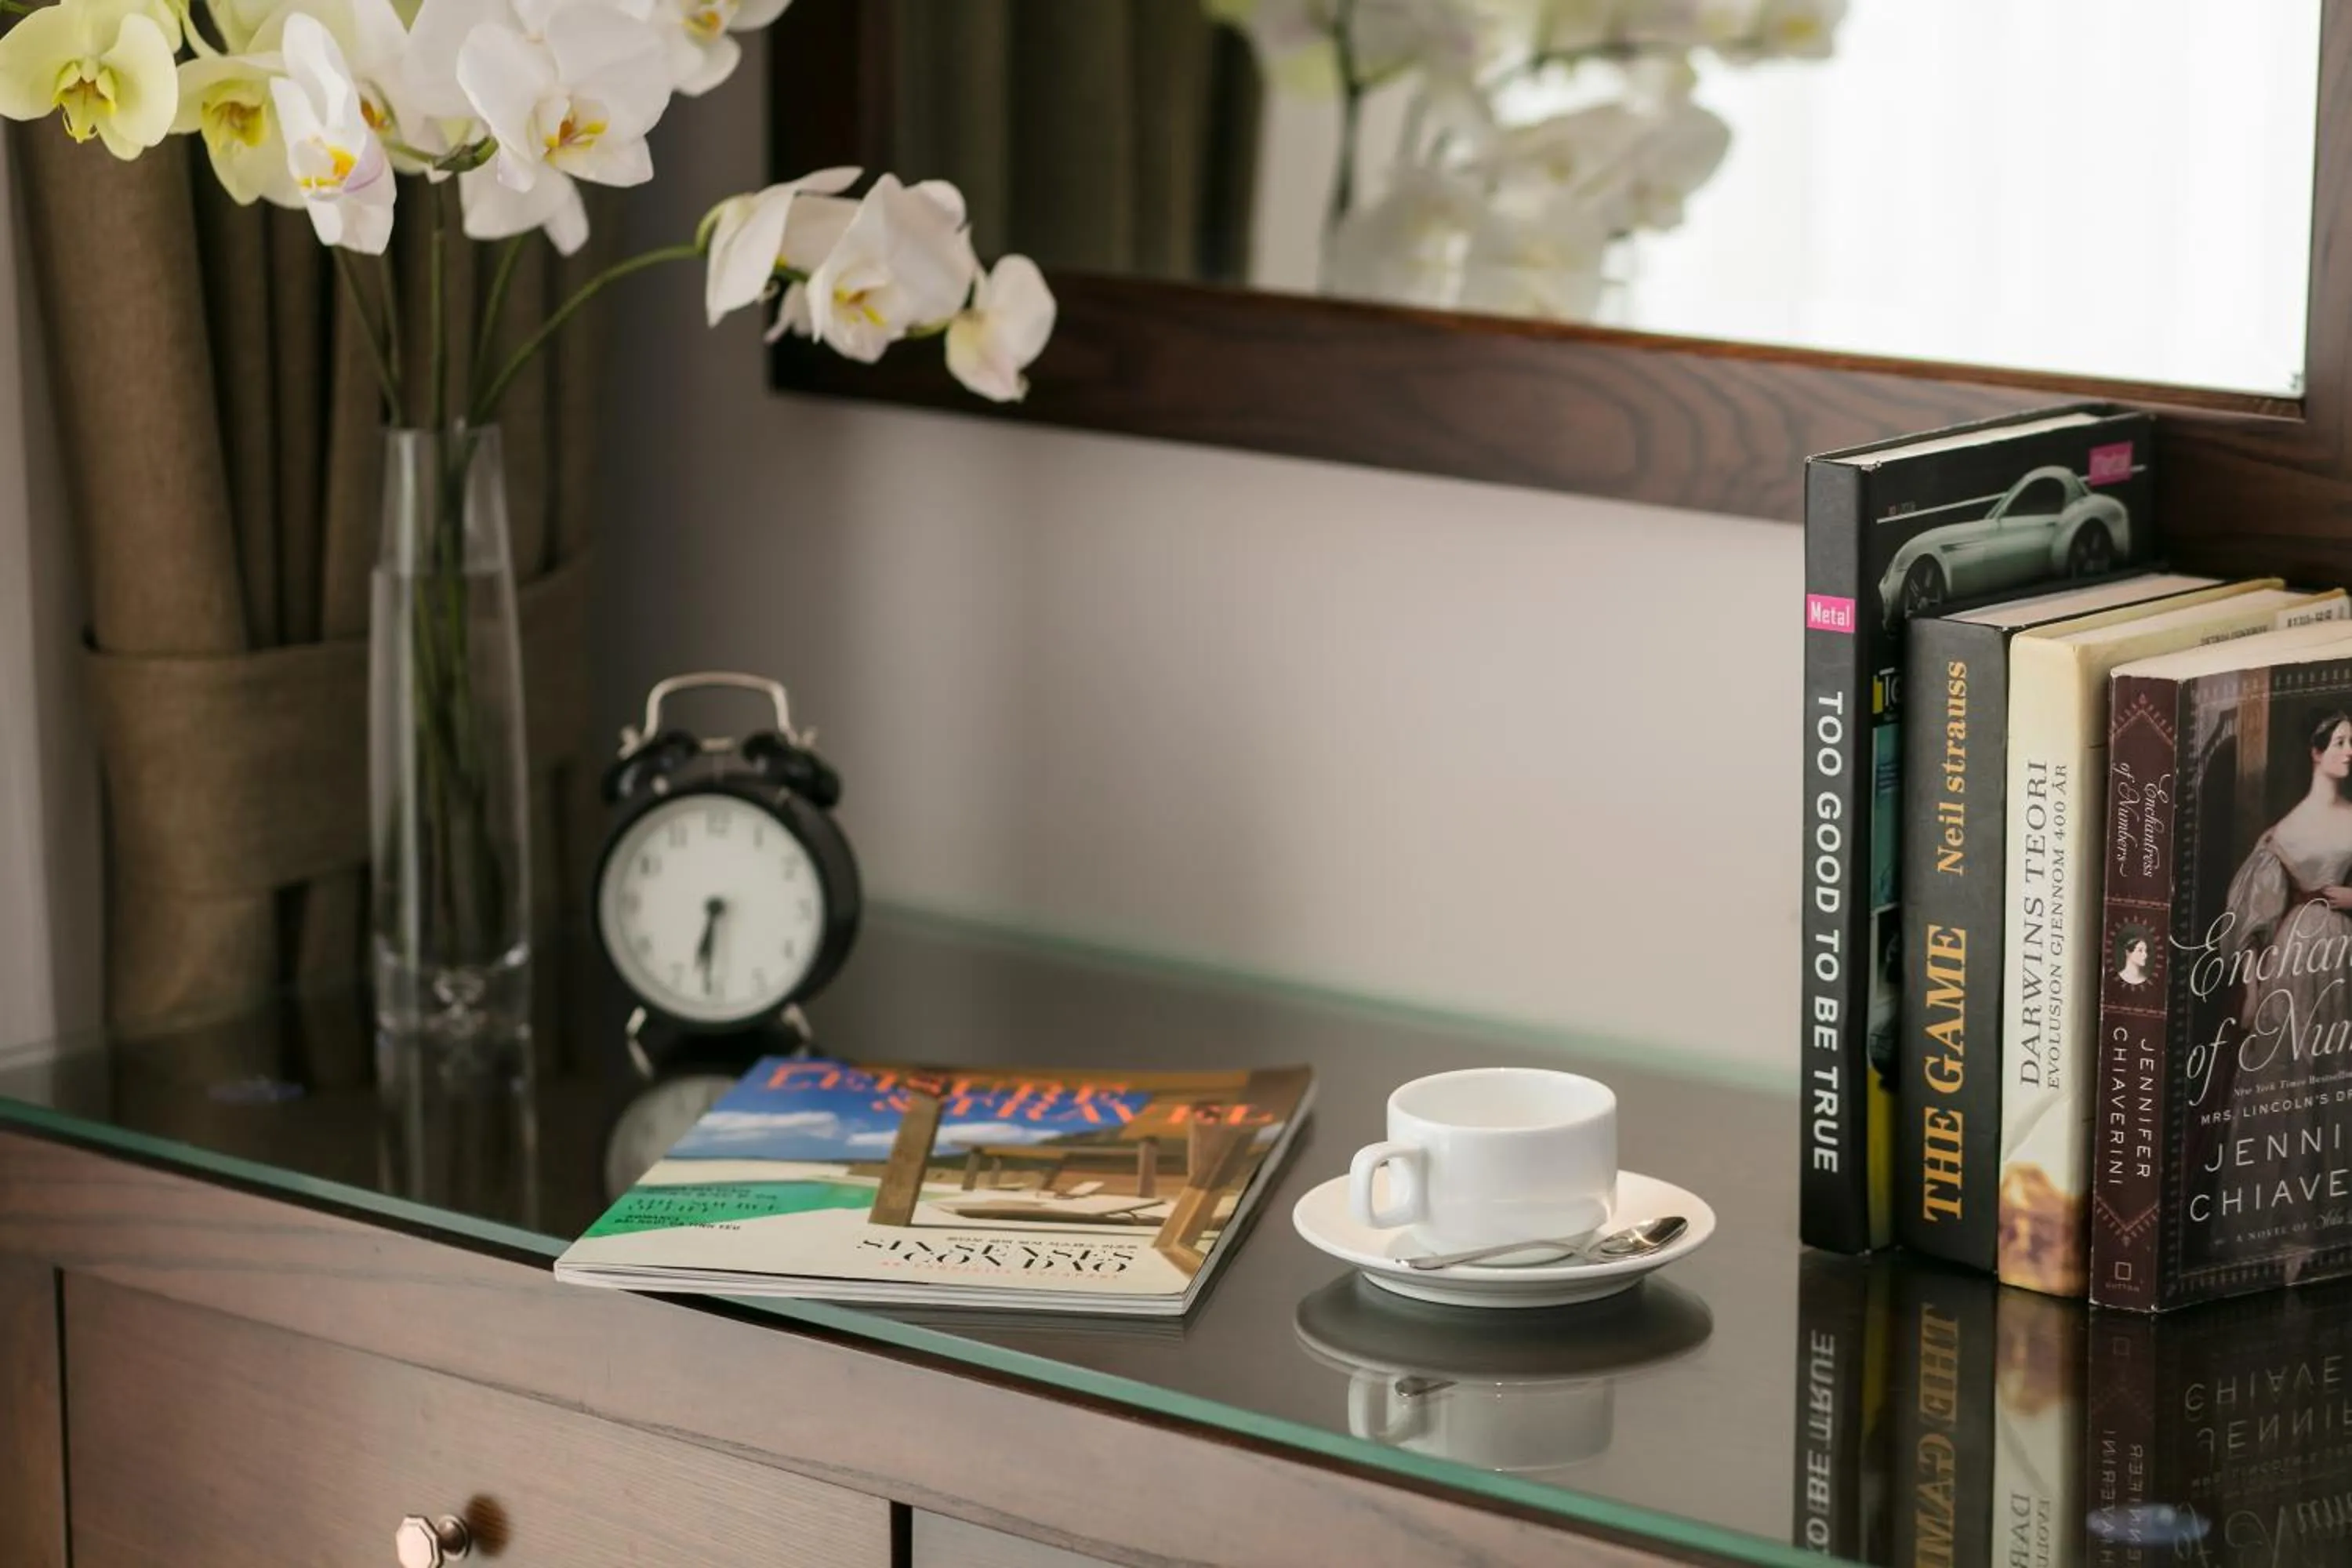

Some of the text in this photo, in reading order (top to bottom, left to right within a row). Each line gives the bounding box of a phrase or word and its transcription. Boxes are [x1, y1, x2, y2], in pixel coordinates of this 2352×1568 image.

[1810, 601, 1850, 627] Metal
[1937, 662, 1967, 877] Neil strauss
[2112, 762, 2140, 877] of Numbers
[2143, 774, 2170, 877] Enchantress
[1813, 691, 1843, 1173] TOO GOOD TO BE TRUE
[2020, 759, 2047, 1088] DARWINS TEORI
[2047, 764, 2067, 1089] EVOLUSJON GJENNOM 400 ÅR
[1923, 924, 1966, 1222] THE GAME
[2108, 1026, 2129, 1184] CHIAVERINI
[2136, 1039, 2155, 1177] JENNIFER
[2187, 1018, 2236, 1106] of
[2243, 1094, 2329, 1118] LINCOLN'S
[2190, 1169, 2350, 1221] CHIAVE
[2205, 1123, 2341, 1173] JENNI
